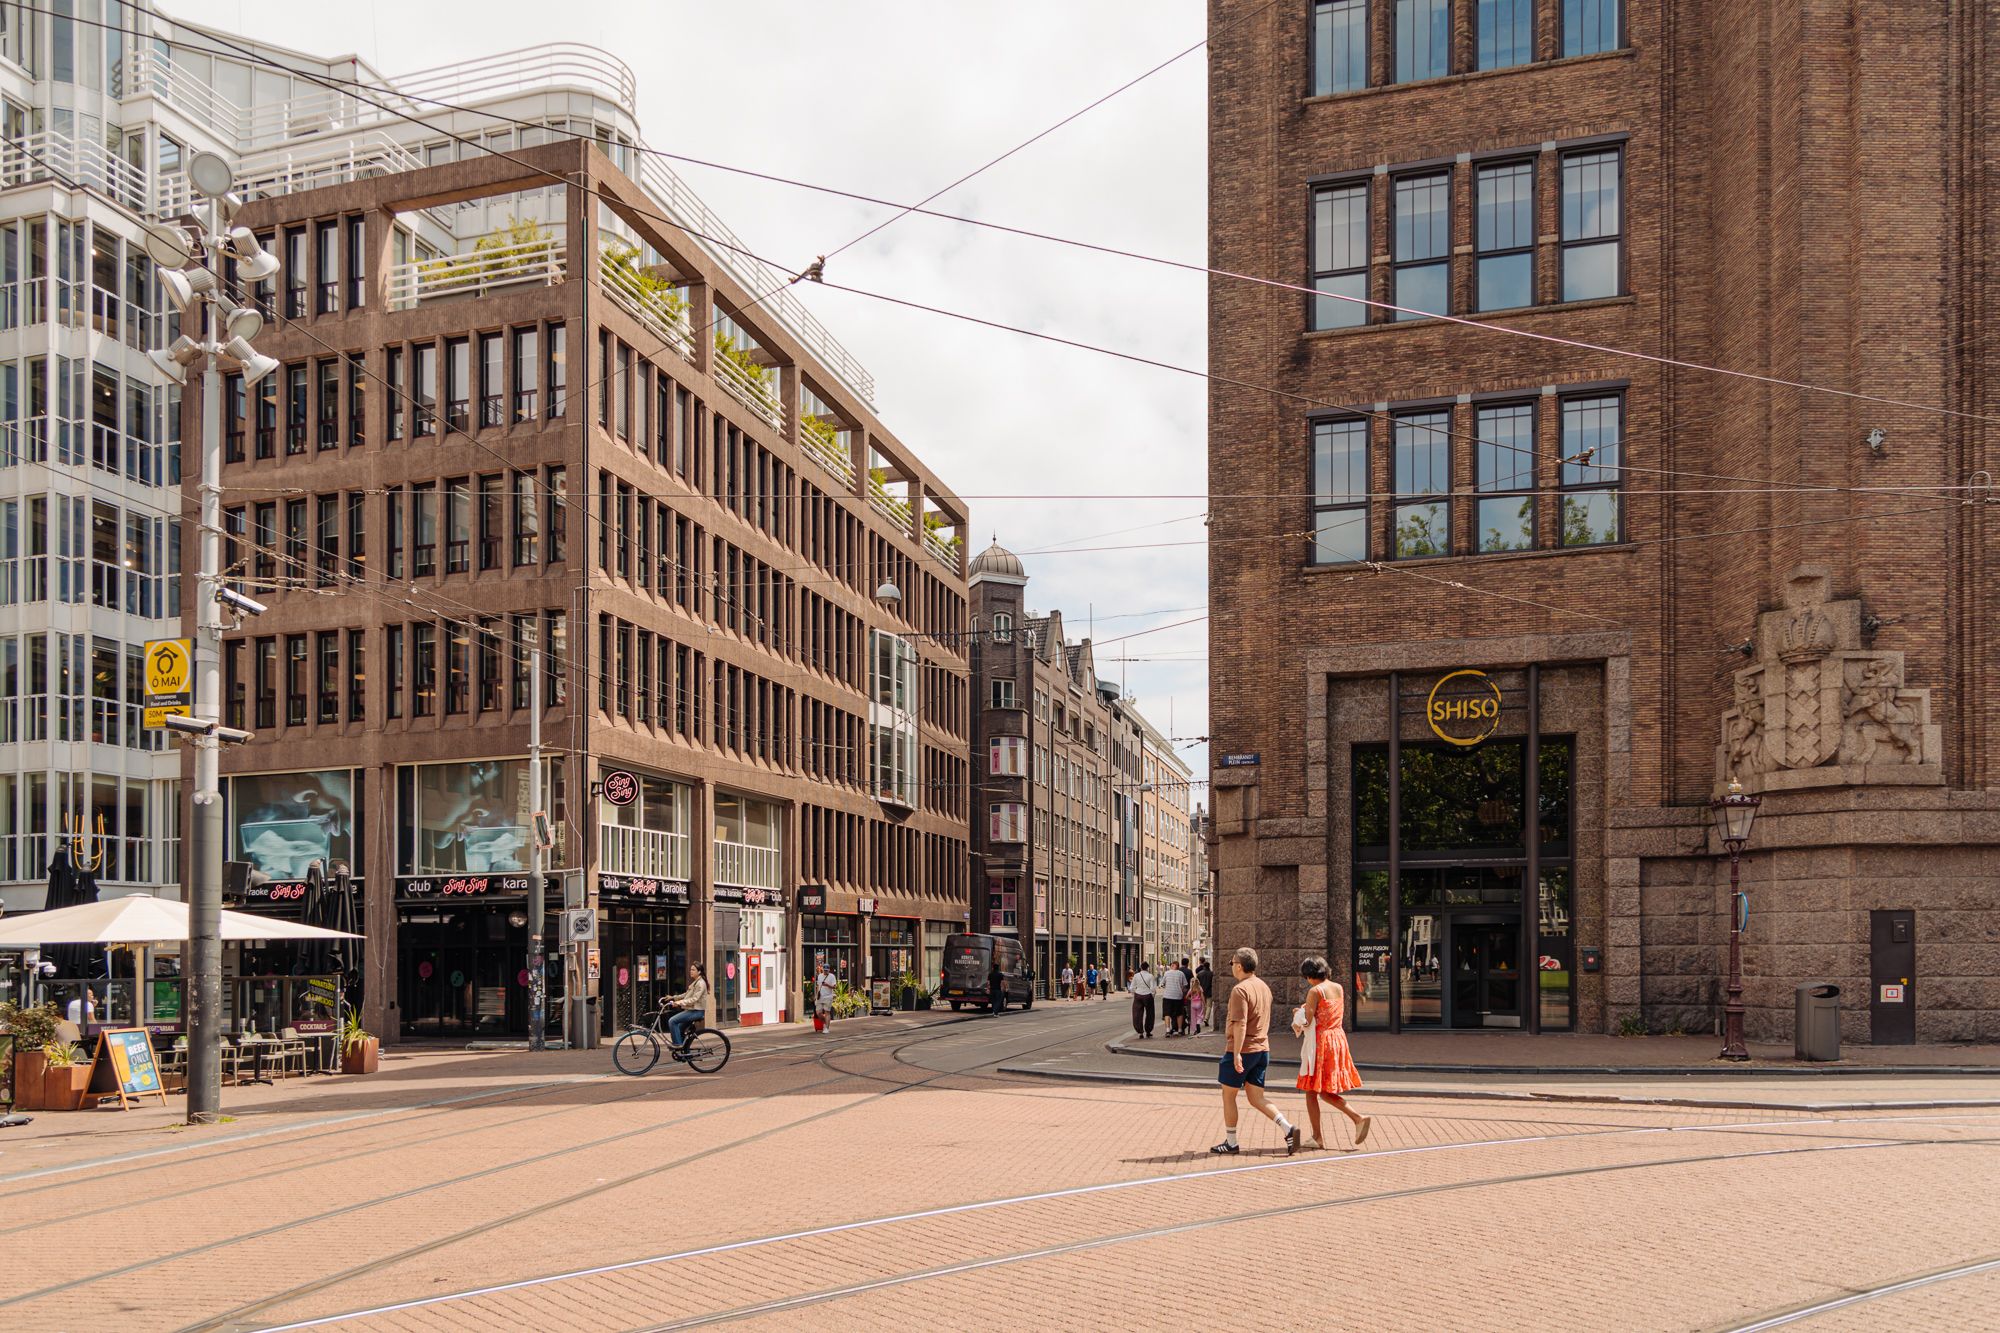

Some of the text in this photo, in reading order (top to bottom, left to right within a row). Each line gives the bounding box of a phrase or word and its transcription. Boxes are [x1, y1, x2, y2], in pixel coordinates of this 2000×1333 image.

[161, 676, 181, 687] MAI
[1433, 699, 1498, 720] SHISO
[608, 776, 631, 789] Sing
[610, 786, 633, 799] Sing
[270, 884, 291, 899] Sing
[408, 877, 549, 894] club Sing Sing karae
[603, 876, 687, 895] club Sing Sing karaoke
[127, 1042, 147, 1055] BEER
[130, 1051, 149, 1065] ONLY
